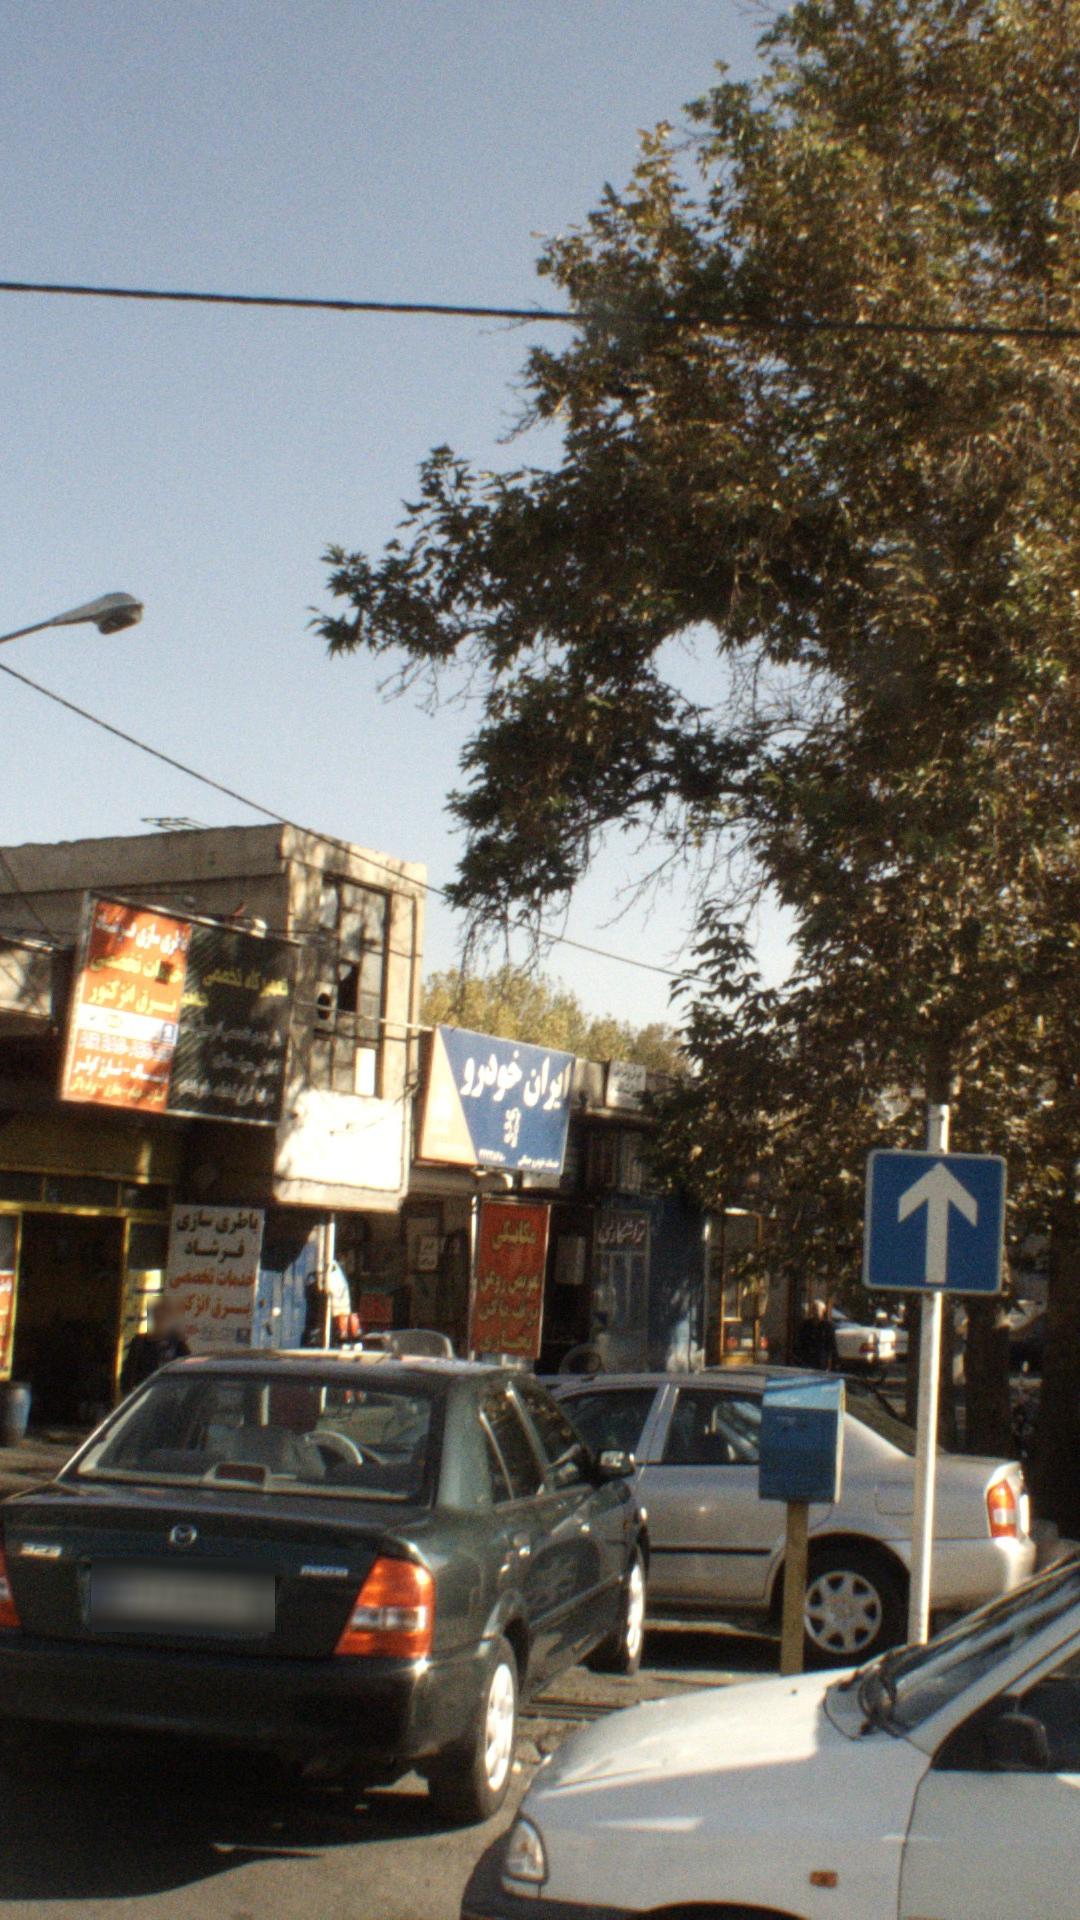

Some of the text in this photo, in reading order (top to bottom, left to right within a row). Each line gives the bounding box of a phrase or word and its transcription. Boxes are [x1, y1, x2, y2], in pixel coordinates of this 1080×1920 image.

[460, 1050, 572, 1111] ایران خودرو
[176, 1209, 259, 1235] باطری سازی
[184, 1238, 245, 1263] فرشاد
